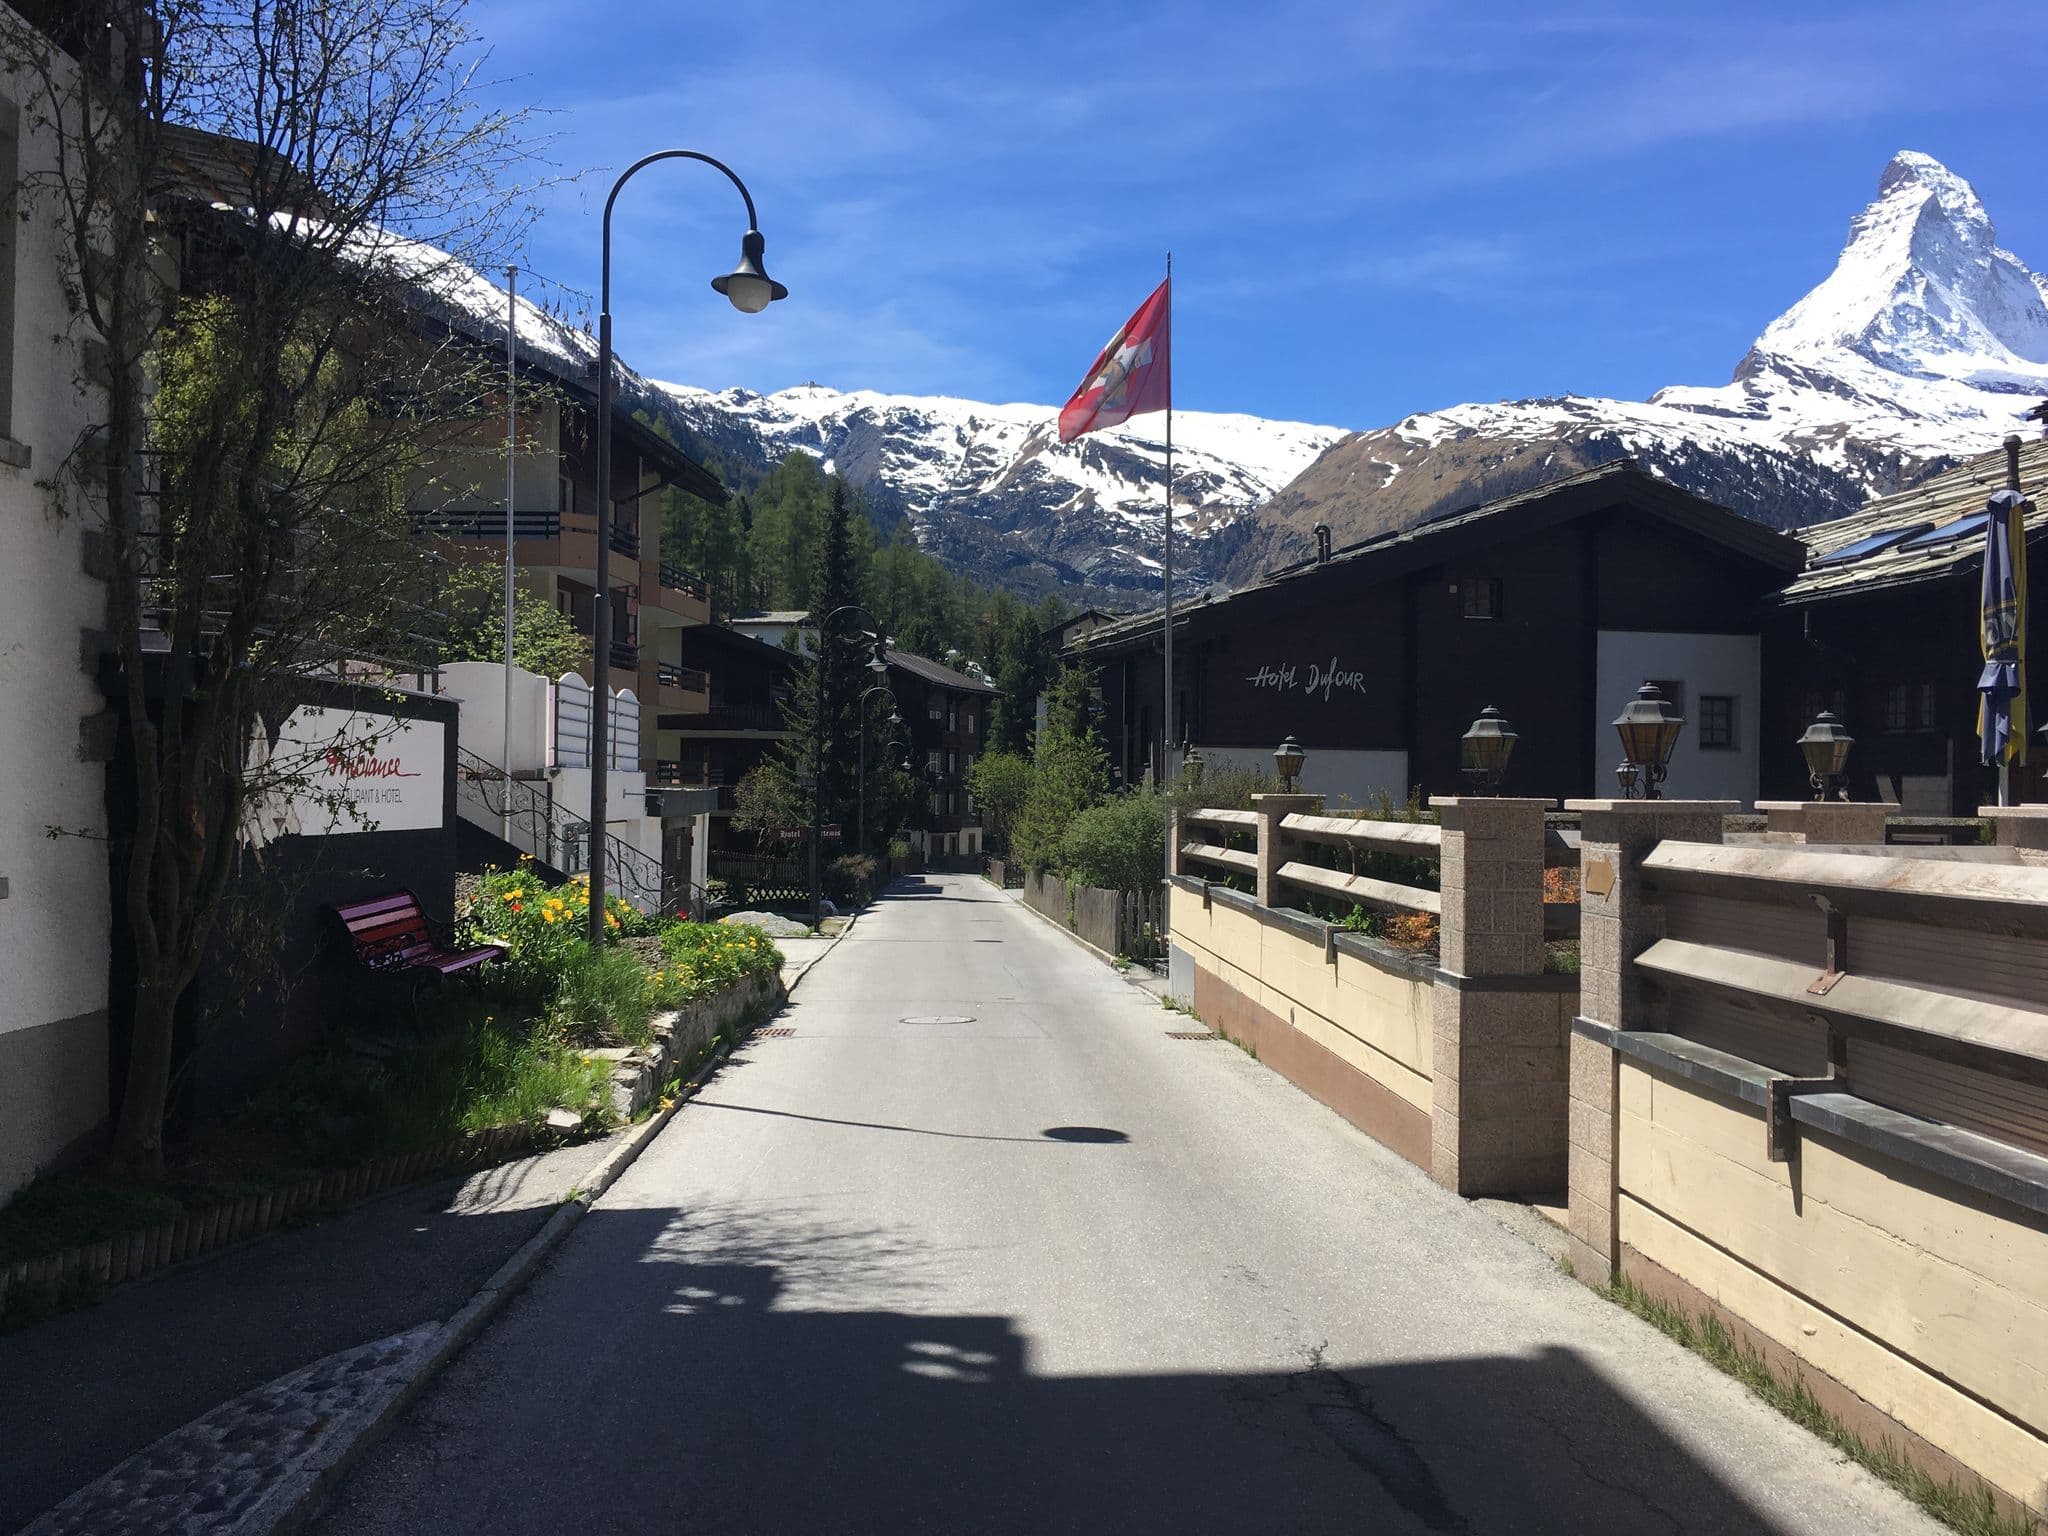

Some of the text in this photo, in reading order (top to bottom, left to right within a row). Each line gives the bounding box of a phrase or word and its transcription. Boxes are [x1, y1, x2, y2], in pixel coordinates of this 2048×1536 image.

[375, 789, 380, 803] &
[381, 788, 402, 803] HOTEL
[780, 829, 801, 838] Hotel
